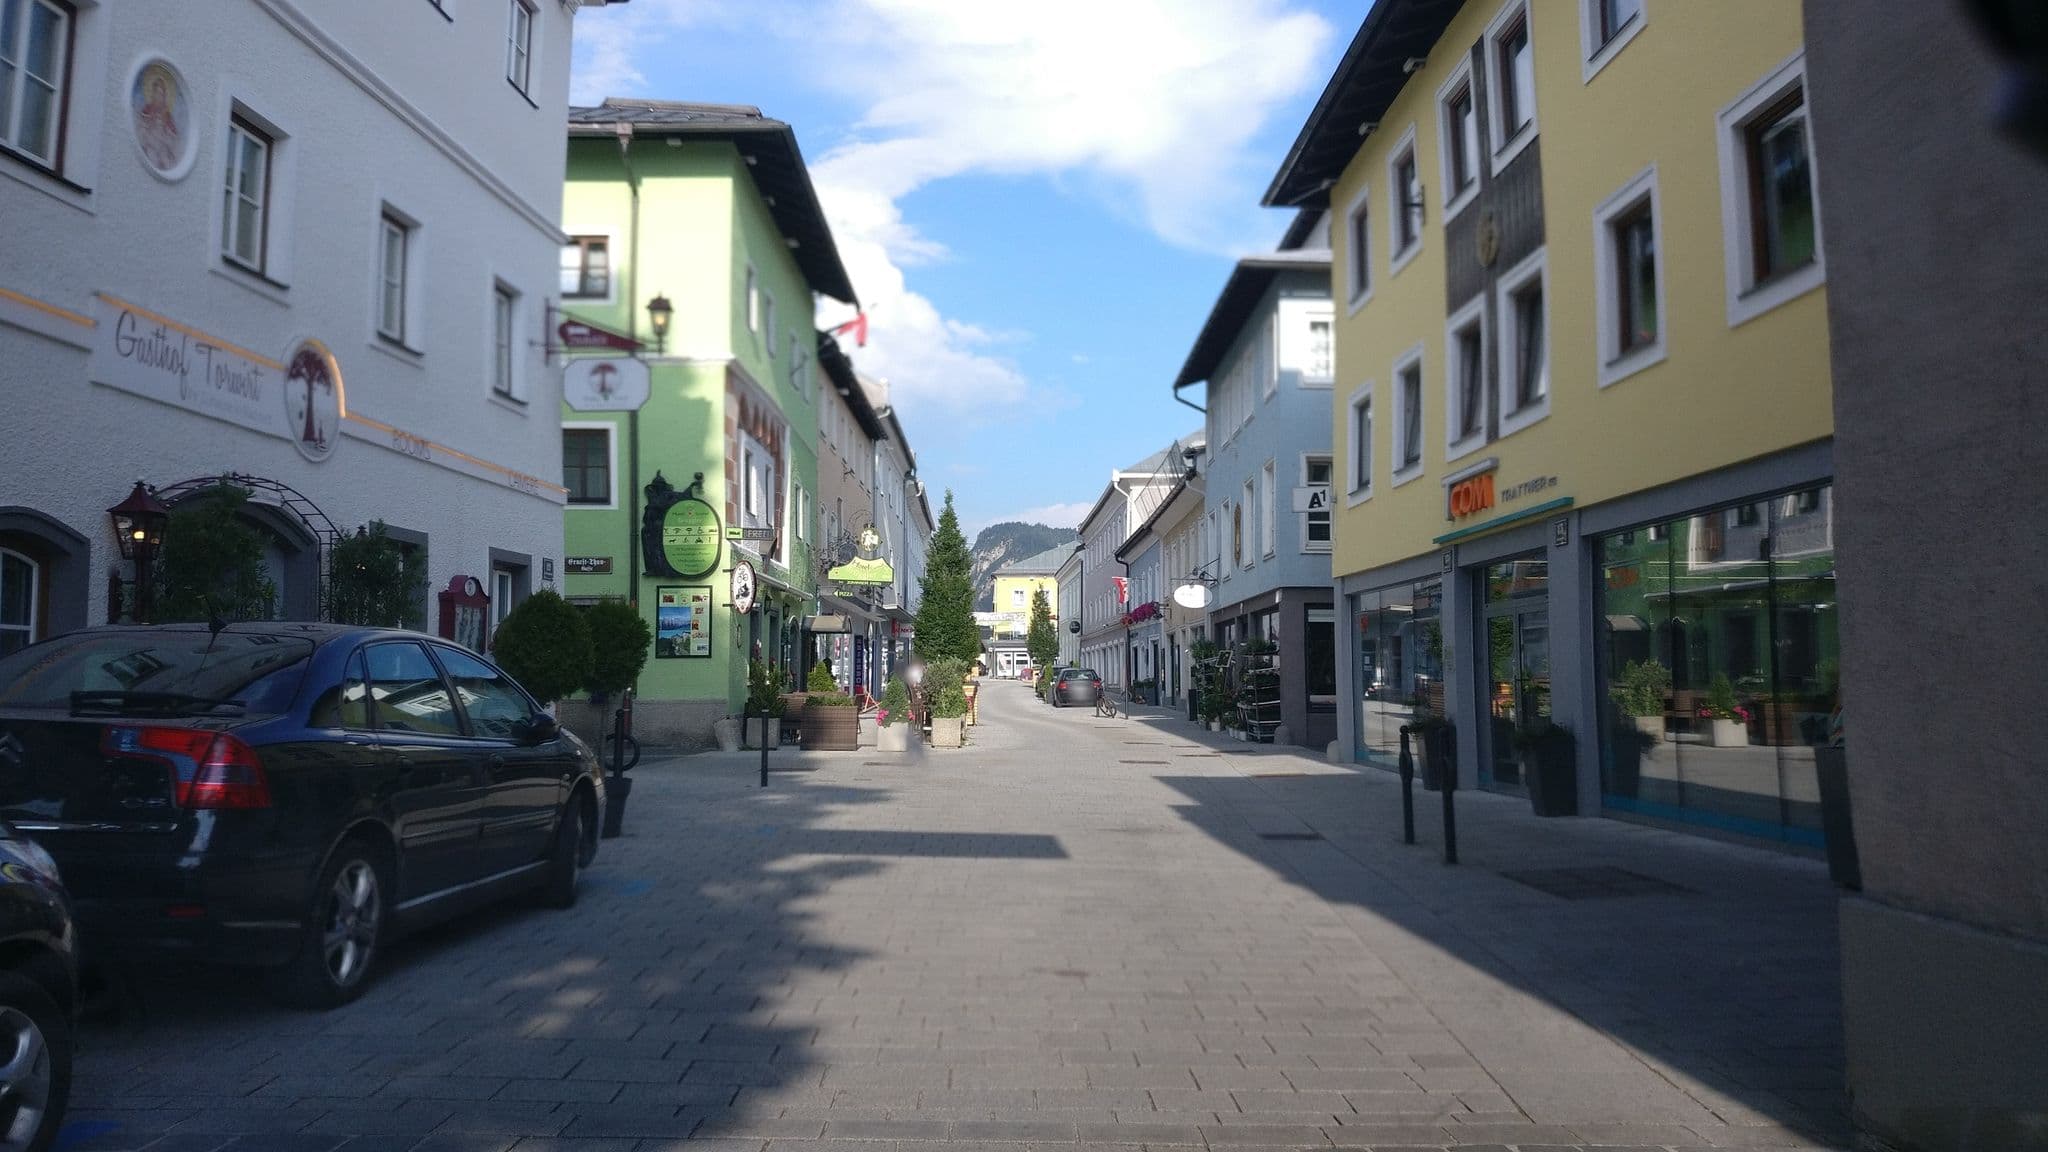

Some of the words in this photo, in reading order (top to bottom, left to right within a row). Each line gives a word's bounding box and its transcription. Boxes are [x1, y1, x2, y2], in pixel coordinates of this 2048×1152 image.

[115, 310, 193, 401] Gasthof
[195, 341, 265, 402] Torwirt
[1308, 489, 1327, 510] A1
